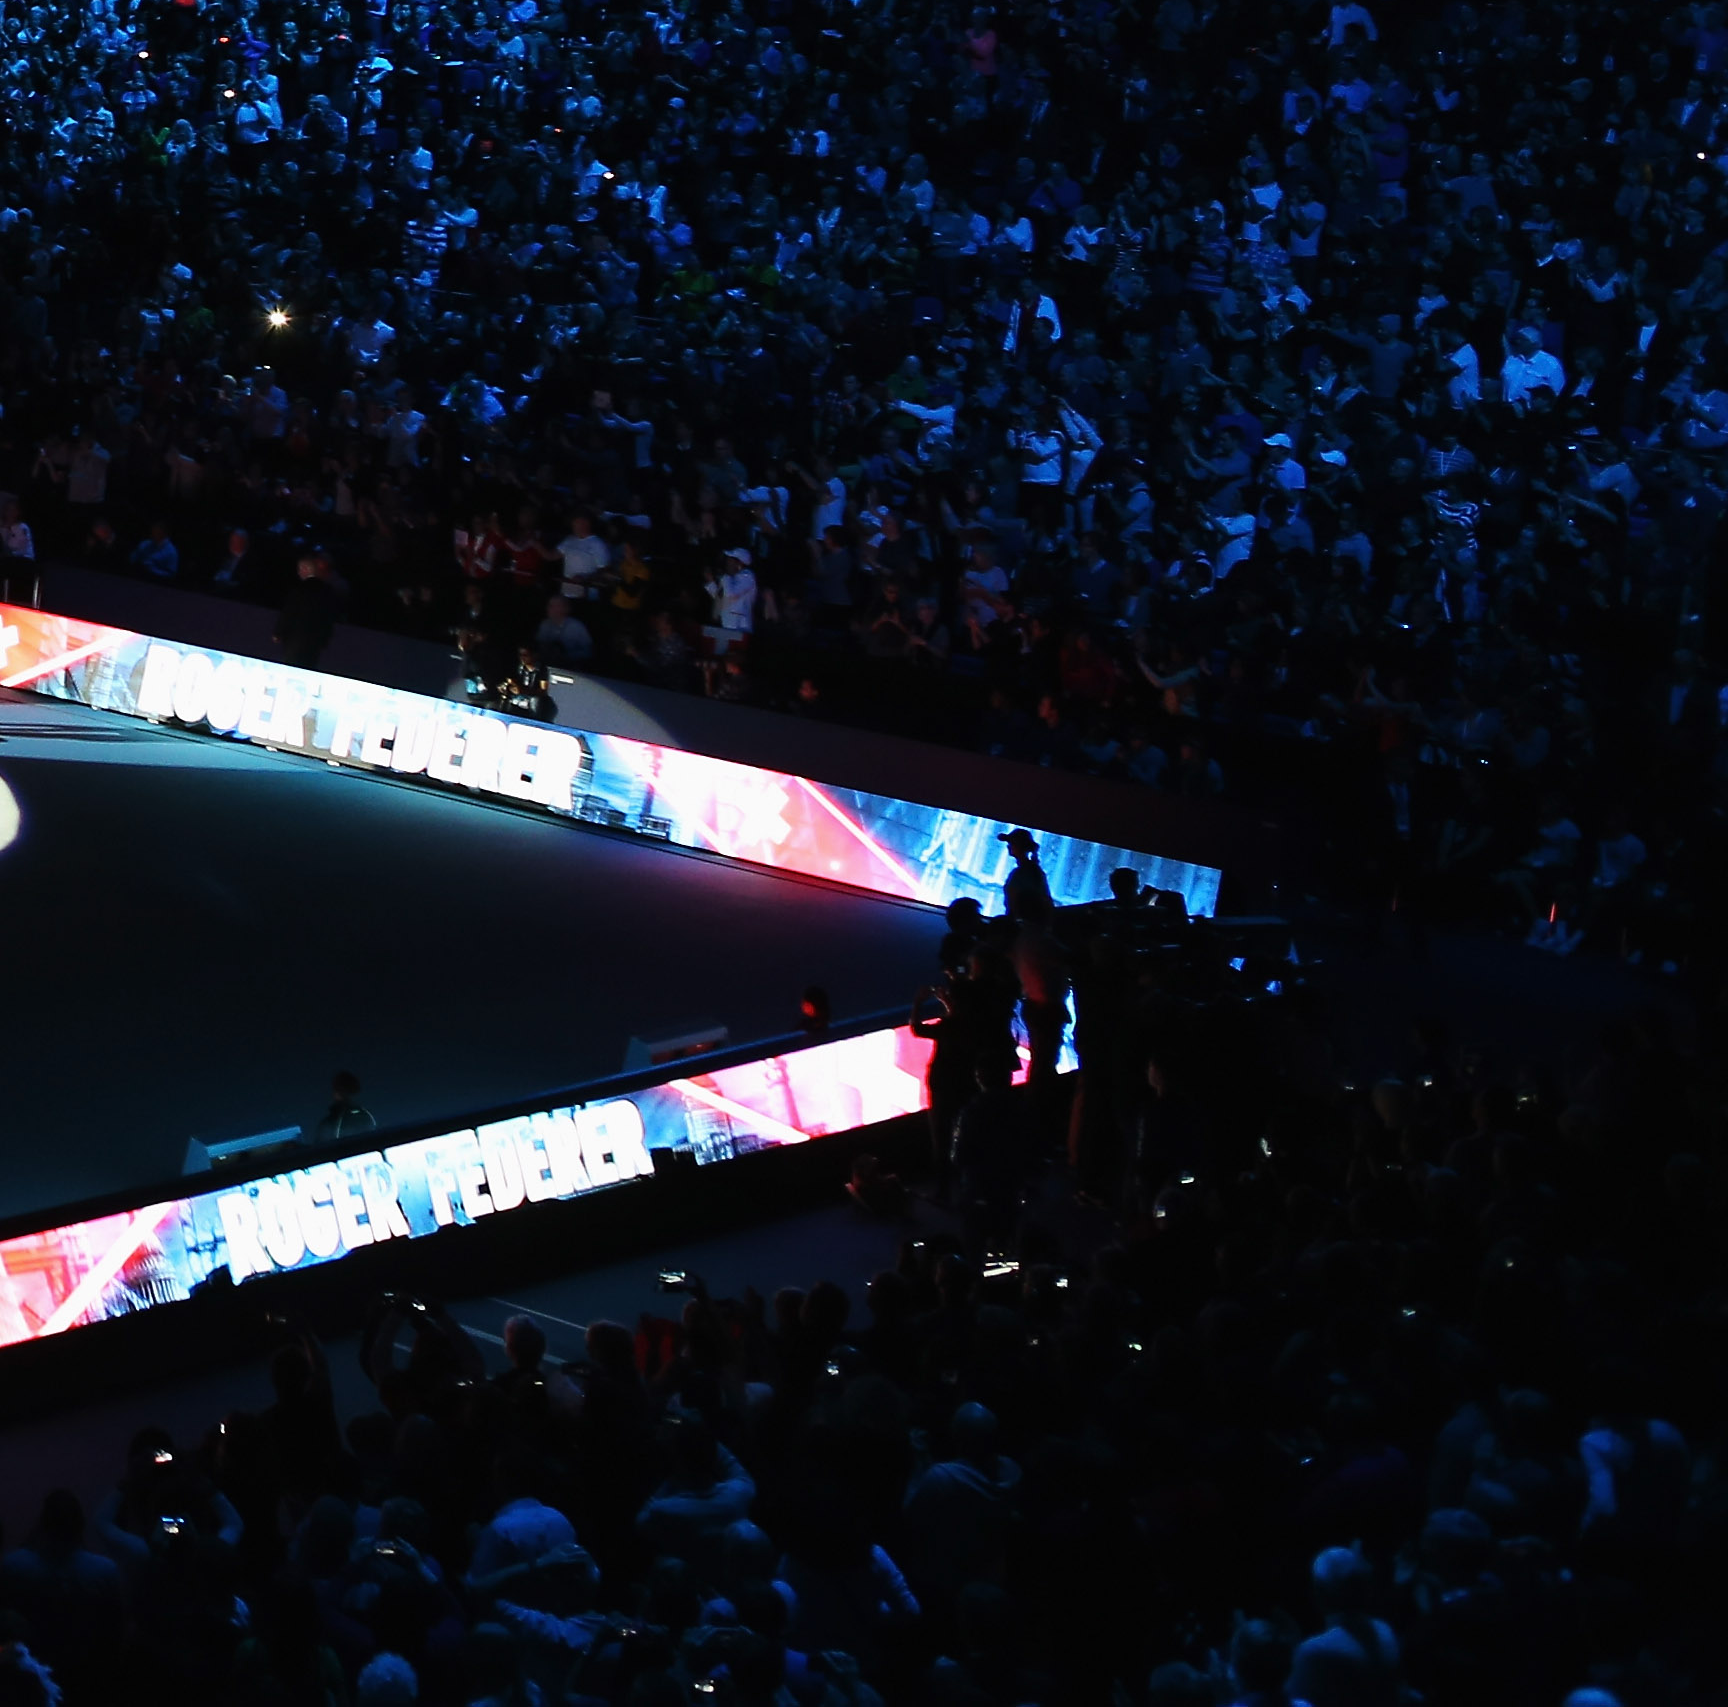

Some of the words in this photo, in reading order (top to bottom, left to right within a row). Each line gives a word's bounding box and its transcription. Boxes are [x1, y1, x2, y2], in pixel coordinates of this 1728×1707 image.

[137, 643, 316, 748] ROGER
[331, 686, 583, 811] FEDERER
[218, 1159, 412, 1286] ROGER
[426, 1097, 655, 1226] FEDERER
